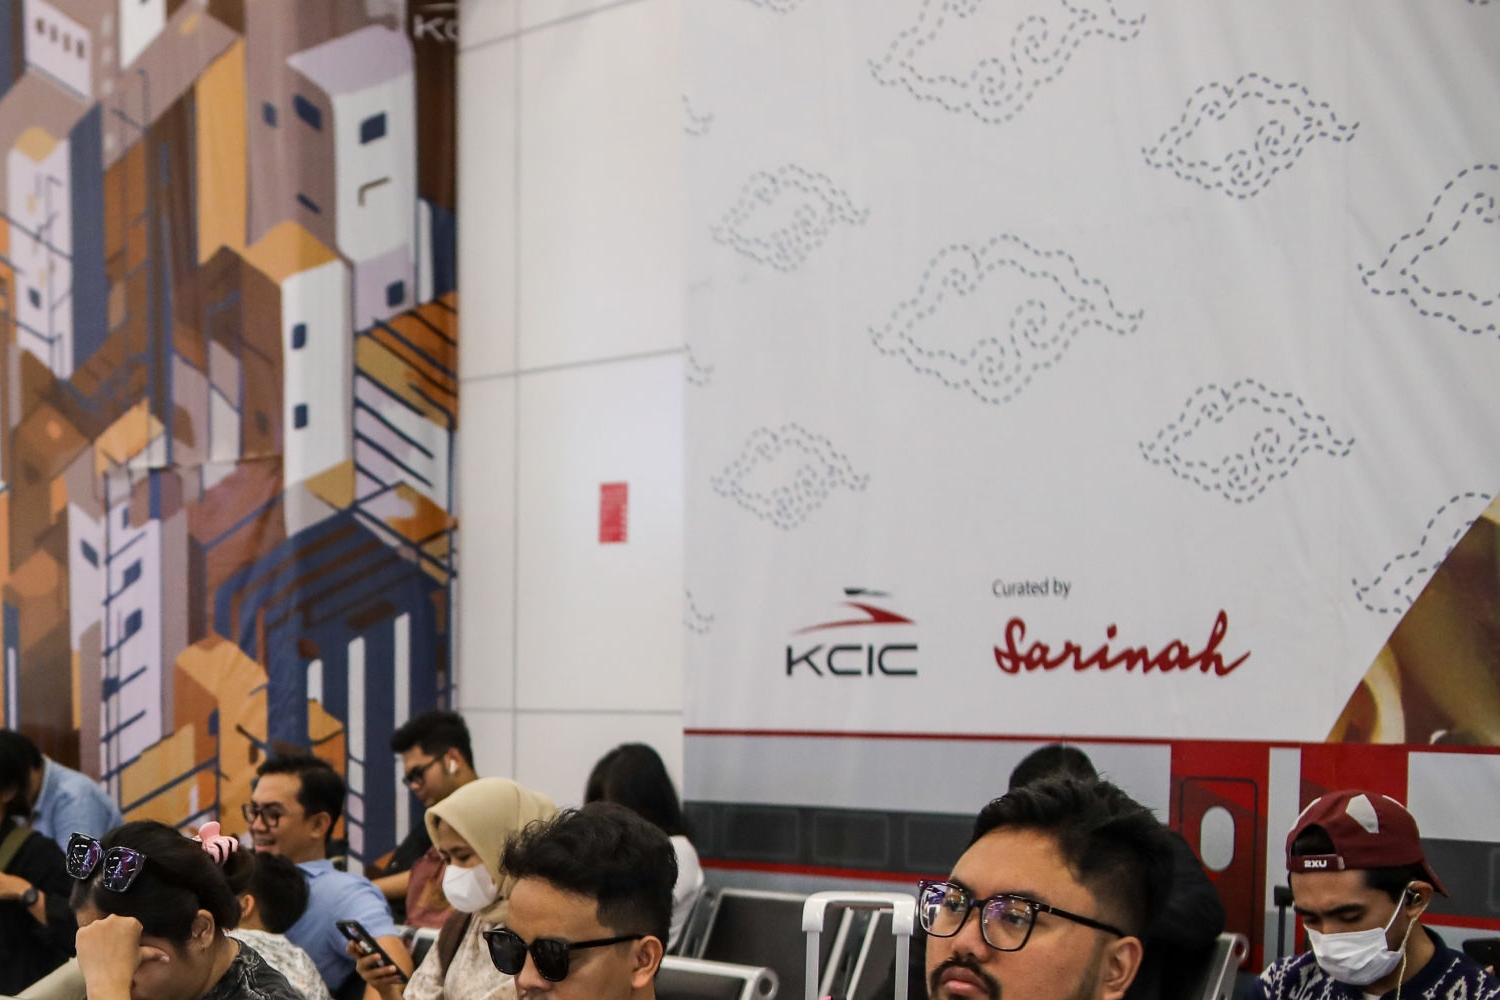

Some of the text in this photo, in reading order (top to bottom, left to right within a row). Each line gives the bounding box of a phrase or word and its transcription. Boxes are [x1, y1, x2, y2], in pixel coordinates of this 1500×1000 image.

[992, 576, 1071, 600] Curated by
[993, 608, 1252, 678] Sarinah
[786, 644, 918, 677] KCIC
[1303, 859, 1328, 869] 2XU
